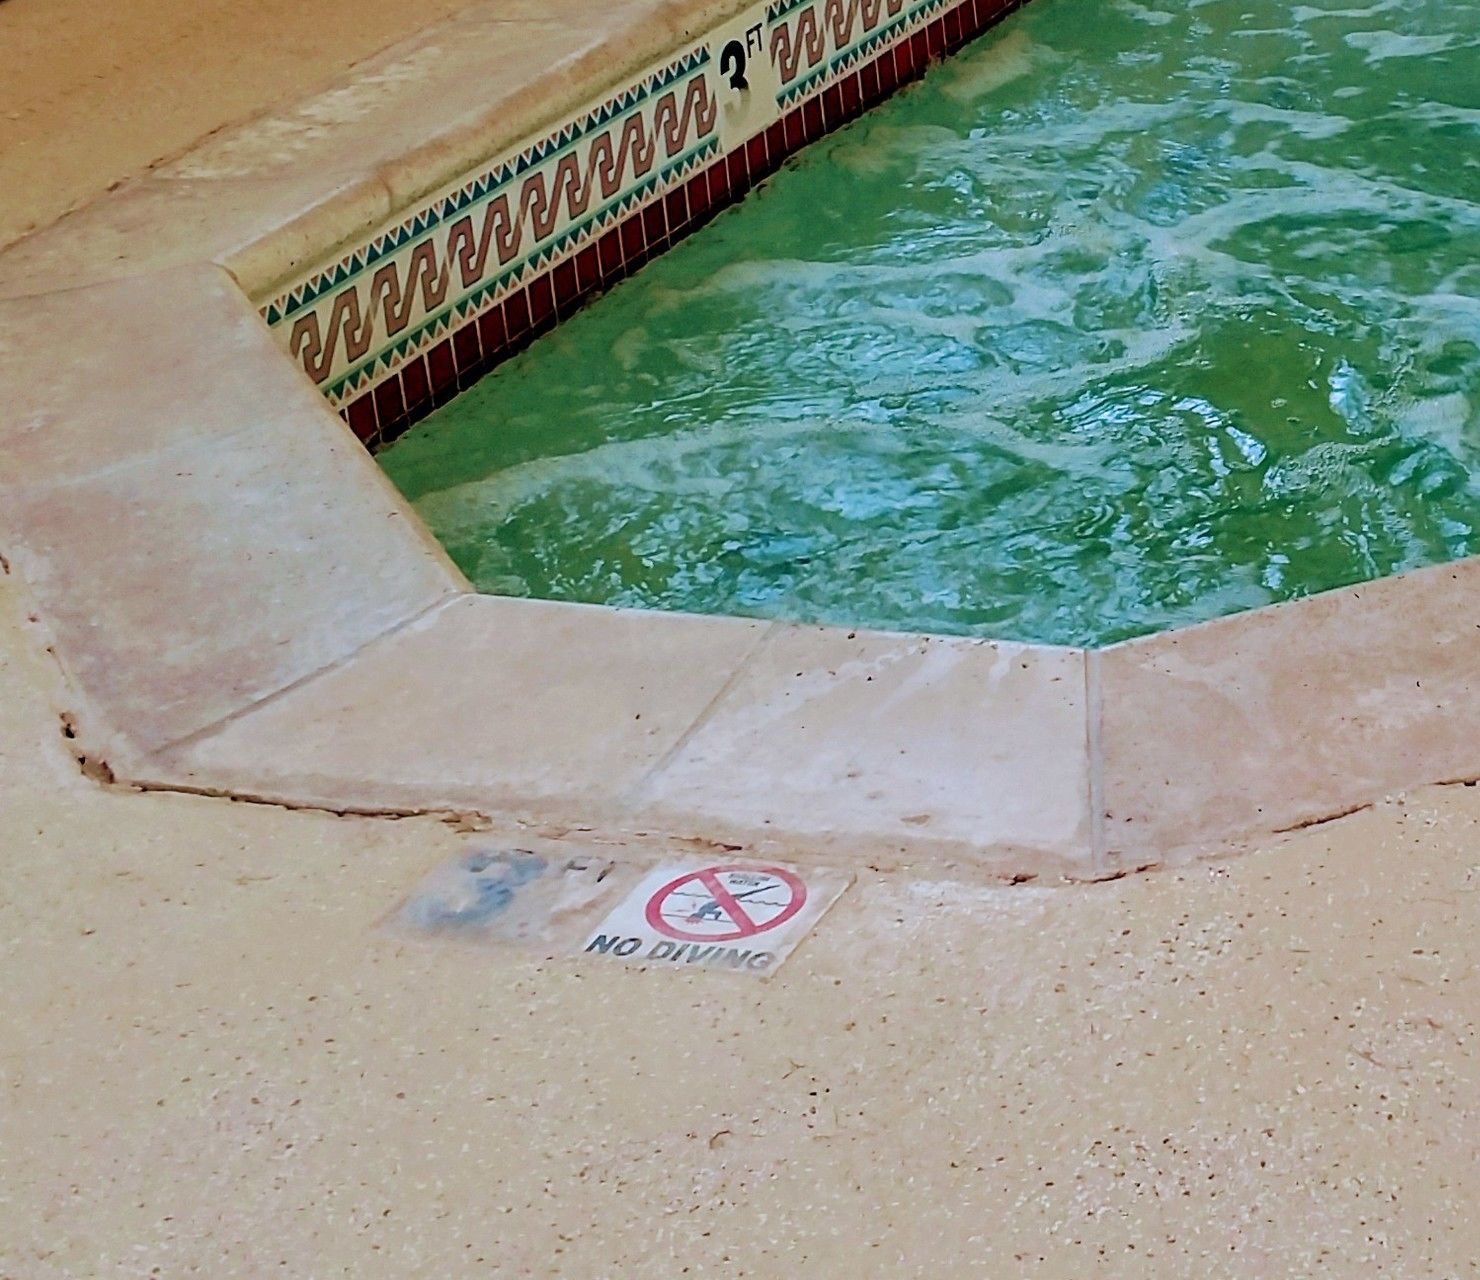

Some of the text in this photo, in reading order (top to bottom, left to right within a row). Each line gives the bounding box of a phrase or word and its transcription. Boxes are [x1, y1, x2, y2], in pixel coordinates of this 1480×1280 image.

[746, 23, 763, 58] FT
[584, 934, 776, 970] NO DIVING
